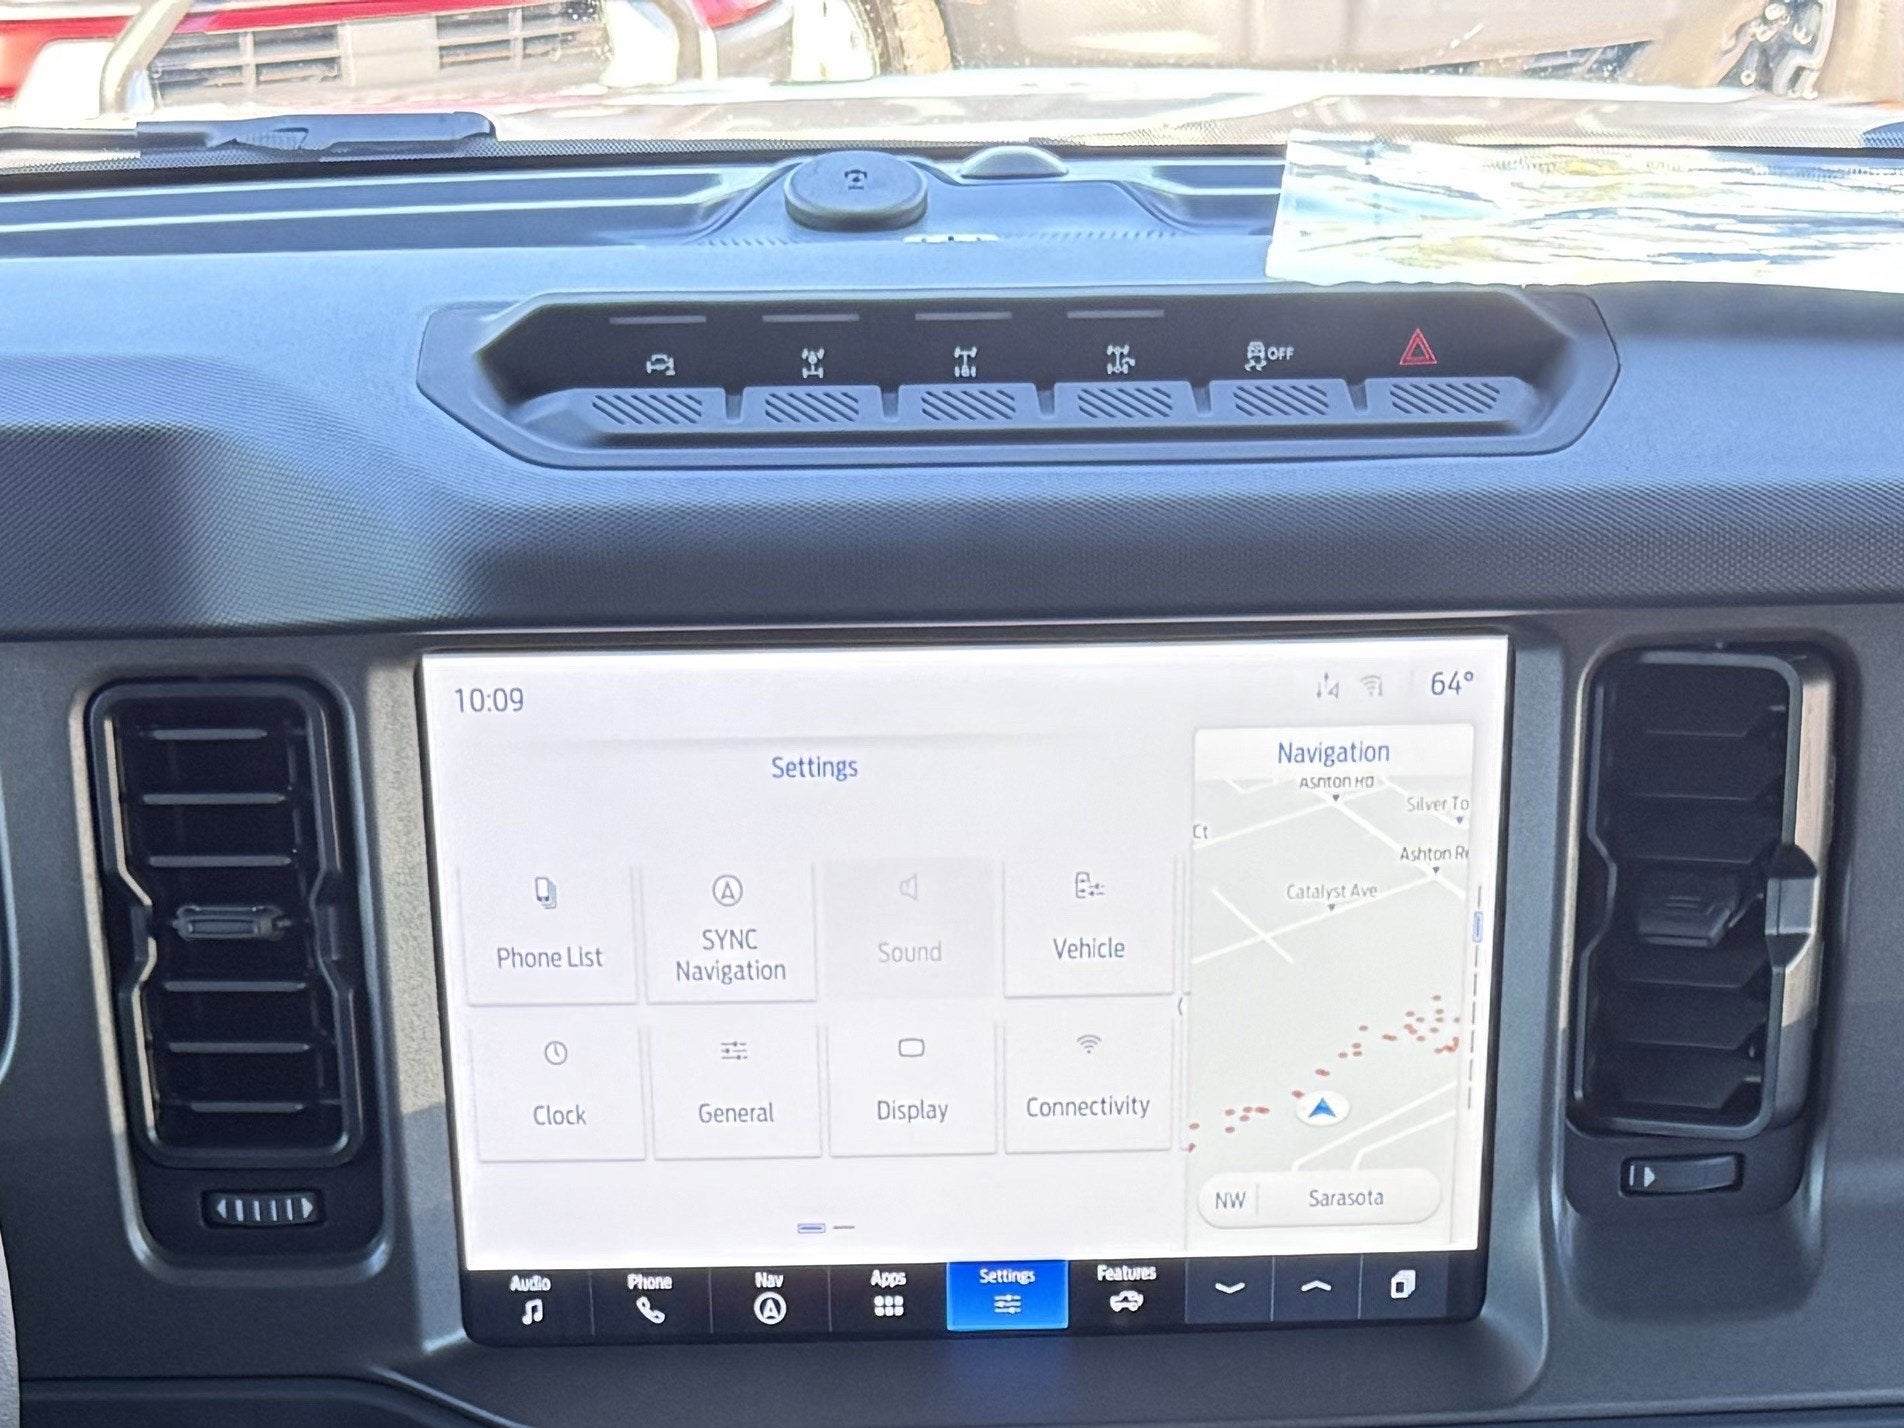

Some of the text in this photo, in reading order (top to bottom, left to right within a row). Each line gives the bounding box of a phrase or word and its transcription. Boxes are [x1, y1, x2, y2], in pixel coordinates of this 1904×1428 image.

[1267, 346, 1294, 362] OFF
[1431, 671, 1474, 696] 64°
[454, 687, 524, 713] 10:09
[1278, 741, 1390, 767] Navigation
[772, 756, 858, 782] Settings
[1406, 796, 1446, 813] Silver
[1399, 846, 1452, 862] Ashton
[1286, 884, 1378, 901] Catalyst Ave
[702, 928, 758, 951] SYNC
[1053, 937, 1126, 961] Vehicle
[496, 946, 603, 970] Phone List
[878, 941, 942, 964] Sound
[676, 961, 786, 985] Navigation
[533, 1105, 586, 1127] Clock
[698, 1102, 774, 1124] General
[877, 1099, 949, 1123] Display
[1026, 1095, 1150, 1120] Connectivity
[1215, 1191, 1247, 1210] NW
[1308, 1187, 1385, 1208] Sarasota
[510, 1275, 551, 1293] Audio
[627, 1273, 673, 1291] Phone
[754, 1272, 784, 1289] Nav
[871, 1269, 907, 1289] Apps
[979, 1266, 1036, 1287] Settings
[1096, 1263, 1157, 1283] Features
